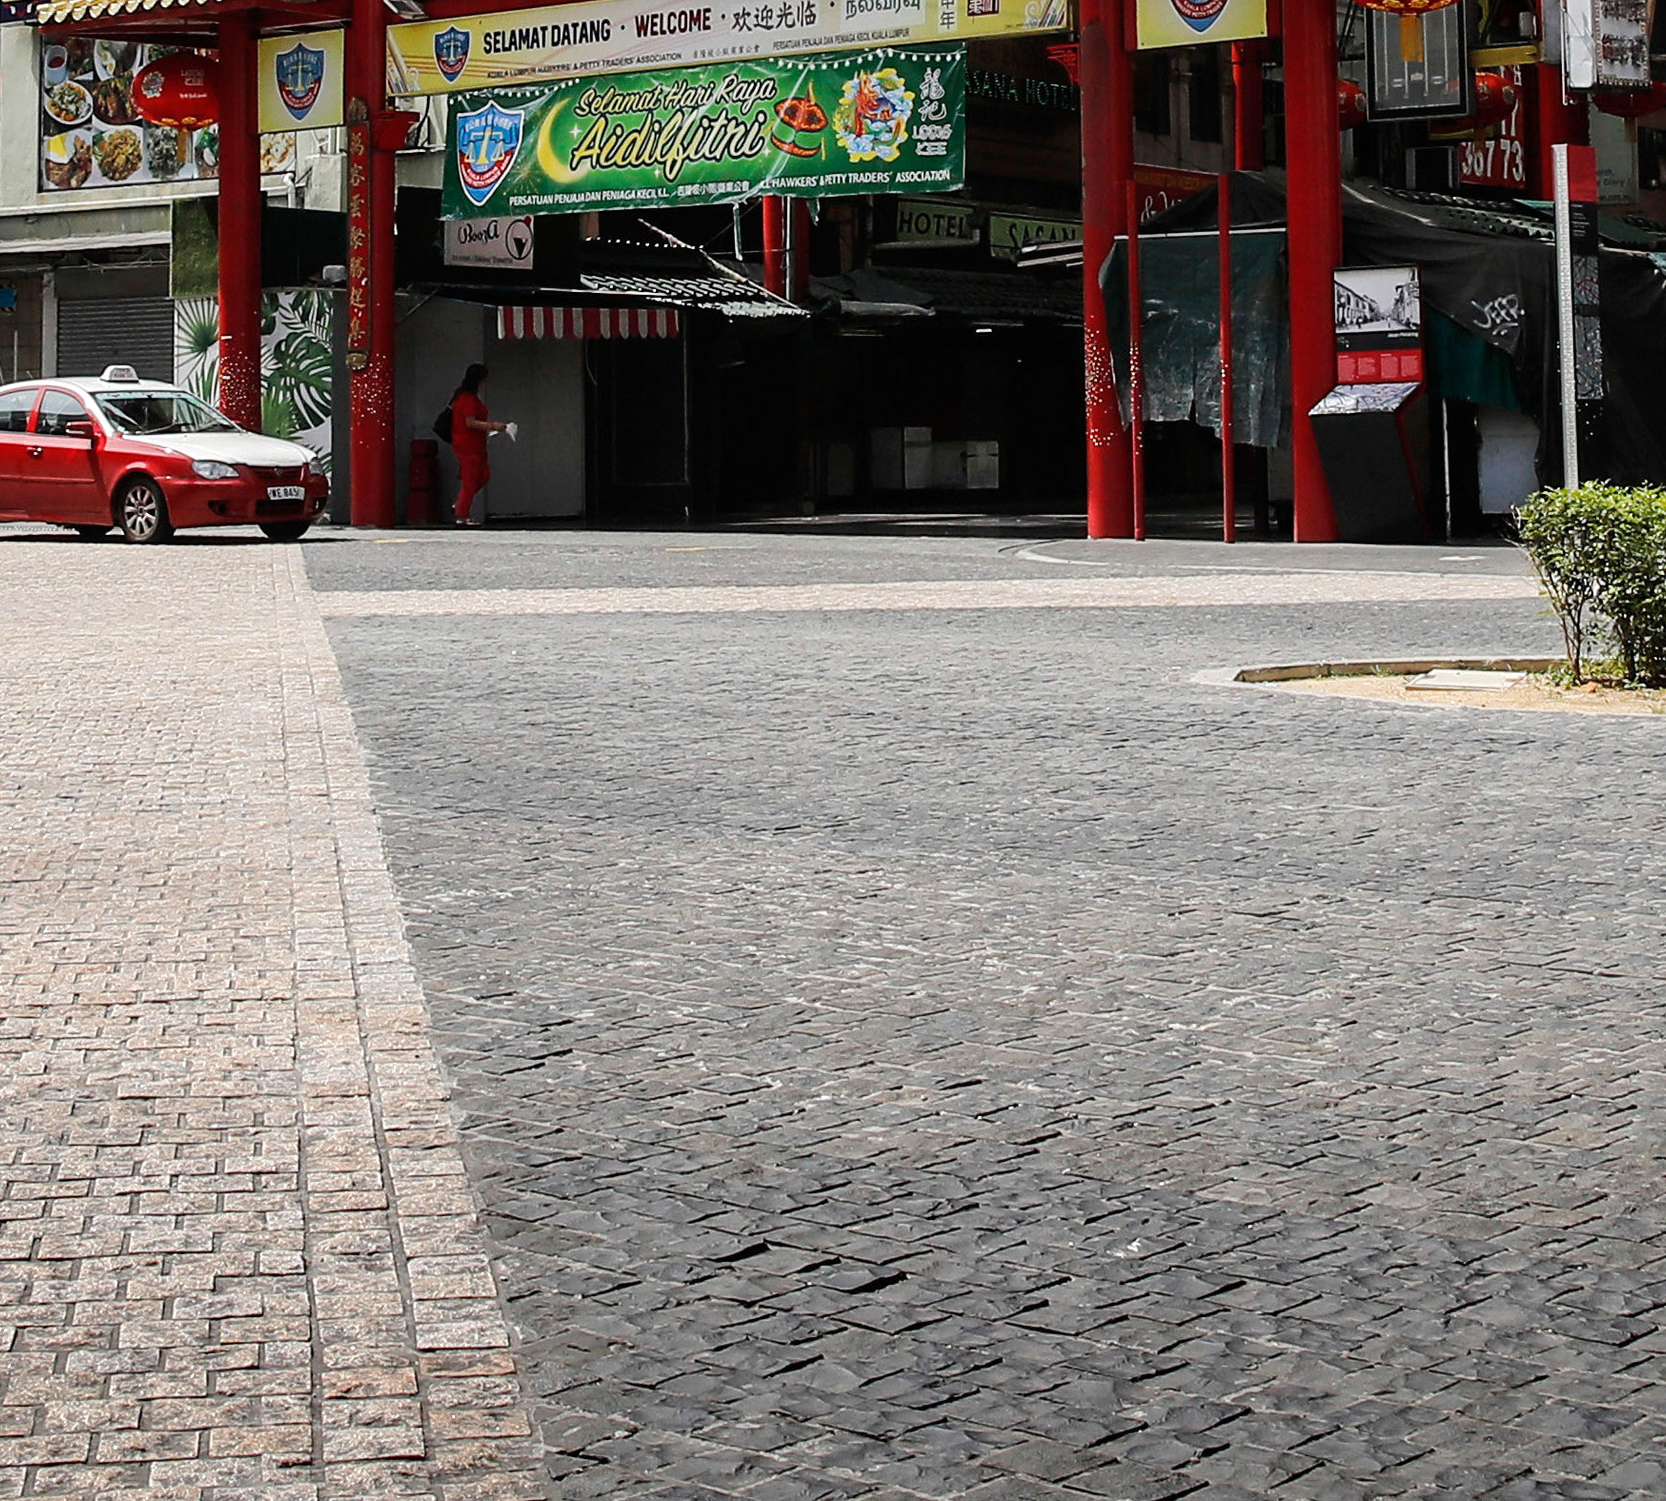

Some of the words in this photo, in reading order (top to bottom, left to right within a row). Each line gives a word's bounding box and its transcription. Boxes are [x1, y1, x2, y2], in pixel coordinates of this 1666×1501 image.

[483, 28, 547, 54] SELAMAT
[550, 19, 611, 47] DATANG
[634, 8, 712, 38] WELCOME
[731, 0, 817, 32] 欢迎光临
[636, 52, 682, 65] ASSOCIATION
[575, 87, 664, 117] Selamat
[667, 79, 714, 109] Hari
[717, 74, 776, 113] Raya
[966, 71, 1019, 101] SANA
[570, 110, 768, 183] Aidilfitri
[1500, 138, 1525, 183] 73
[895, 170, 950, 183] ASSOCIATION
[509, 195, 553, 206] PERSATUAN
[899, 211, 969, 239] HOTEL
